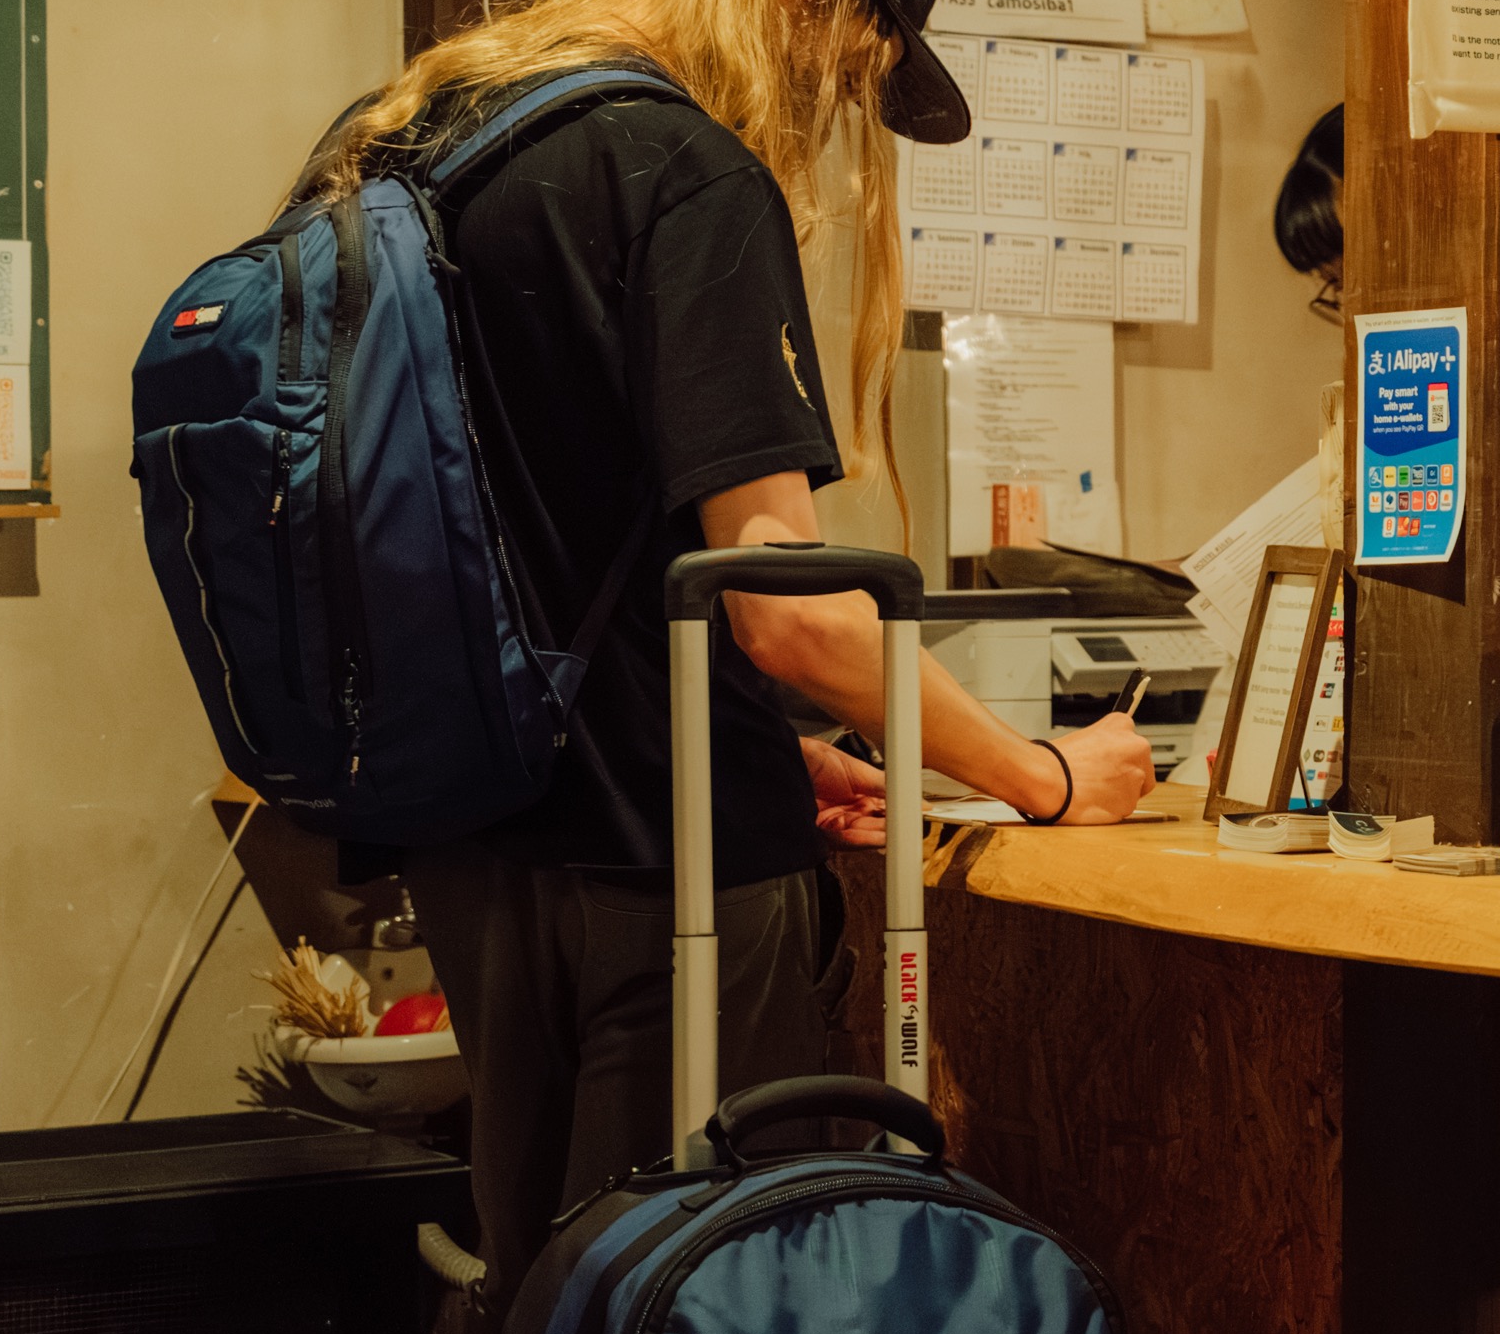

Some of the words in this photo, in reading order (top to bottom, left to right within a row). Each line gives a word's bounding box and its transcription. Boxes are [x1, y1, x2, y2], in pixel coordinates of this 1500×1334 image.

[1468, 36, 1482, 45] the
[1473, 51, 1482, 59] to
[1484, 51, 1495, 59] be
[1378, 387, 1394, 401] Pay
[1394, 385, 1418, 398] smart
[1383, 401, 1398, 412] with
[1398, 402, 1414, 413] your
[1373, 414, 1392, 424] home
